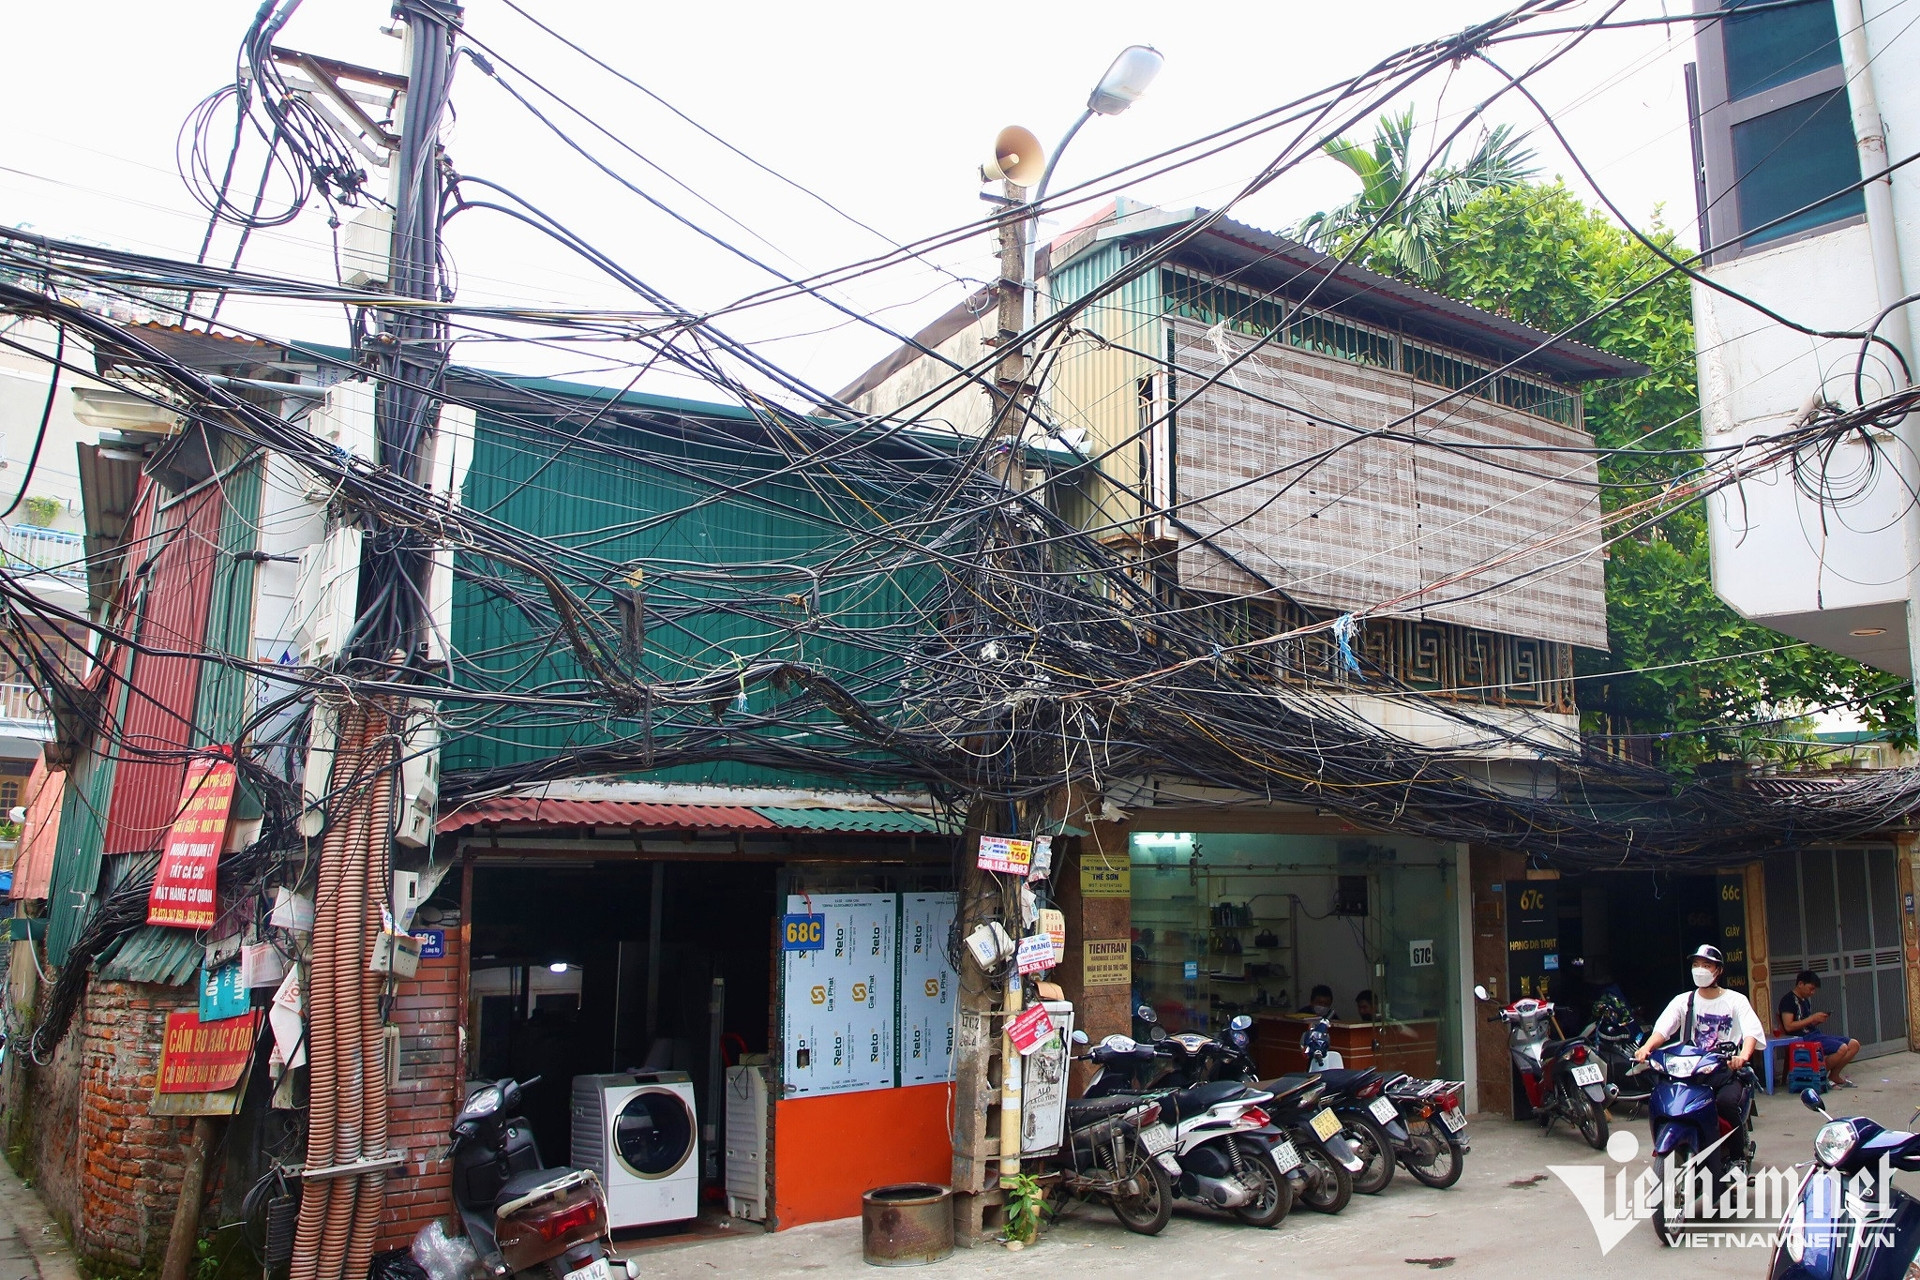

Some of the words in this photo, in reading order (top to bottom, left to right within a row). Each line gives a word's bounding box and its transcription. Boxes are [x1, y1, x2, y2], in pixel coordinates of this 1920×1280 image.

[786, 922, 821, 943] 68C
[835, 928, 844, 957] Reto
[872, 927, 880, 956] Reto
[914, 925, 922, 953] Reto
[1088, 943, 1127, 954] TIENTRAN
[1413, 947, 1431, 964] 67C
[169, 1022, 194, 1054] CẤM
[208, 1023, 229, 1051] RÁC
[834, 1036, 842, 1066] Reto
[871, 1033, 879, 1063] Reto
[913, 1029, 921, 1058] Reto
